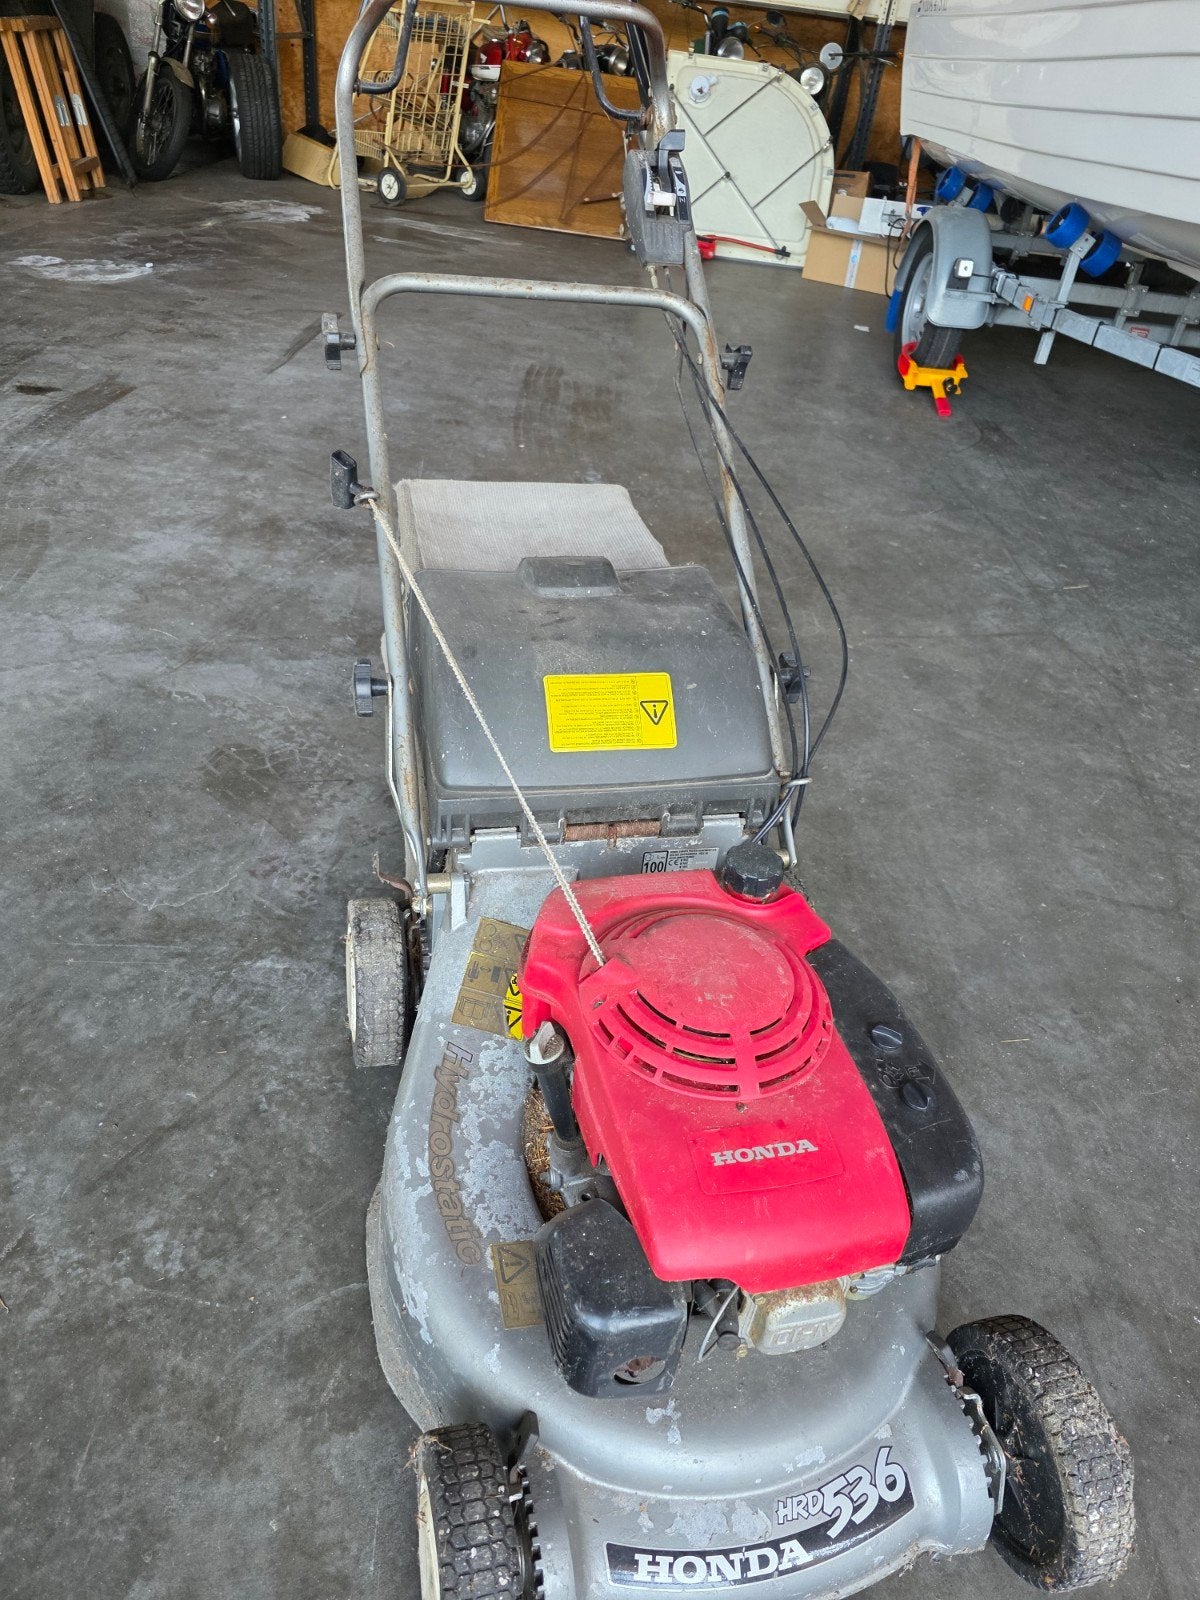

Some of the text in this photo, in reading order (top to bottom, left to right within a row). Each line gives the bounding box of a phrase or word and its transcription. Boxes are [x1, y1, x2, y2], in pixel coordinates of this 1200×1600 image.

[643, 861, 664, 873] 100
[429, 1041, 482, 1267] Hydrostatic
[711, 1139, 818, 1166] HONDA
[633, 1539, 813, 1583] HONDA
